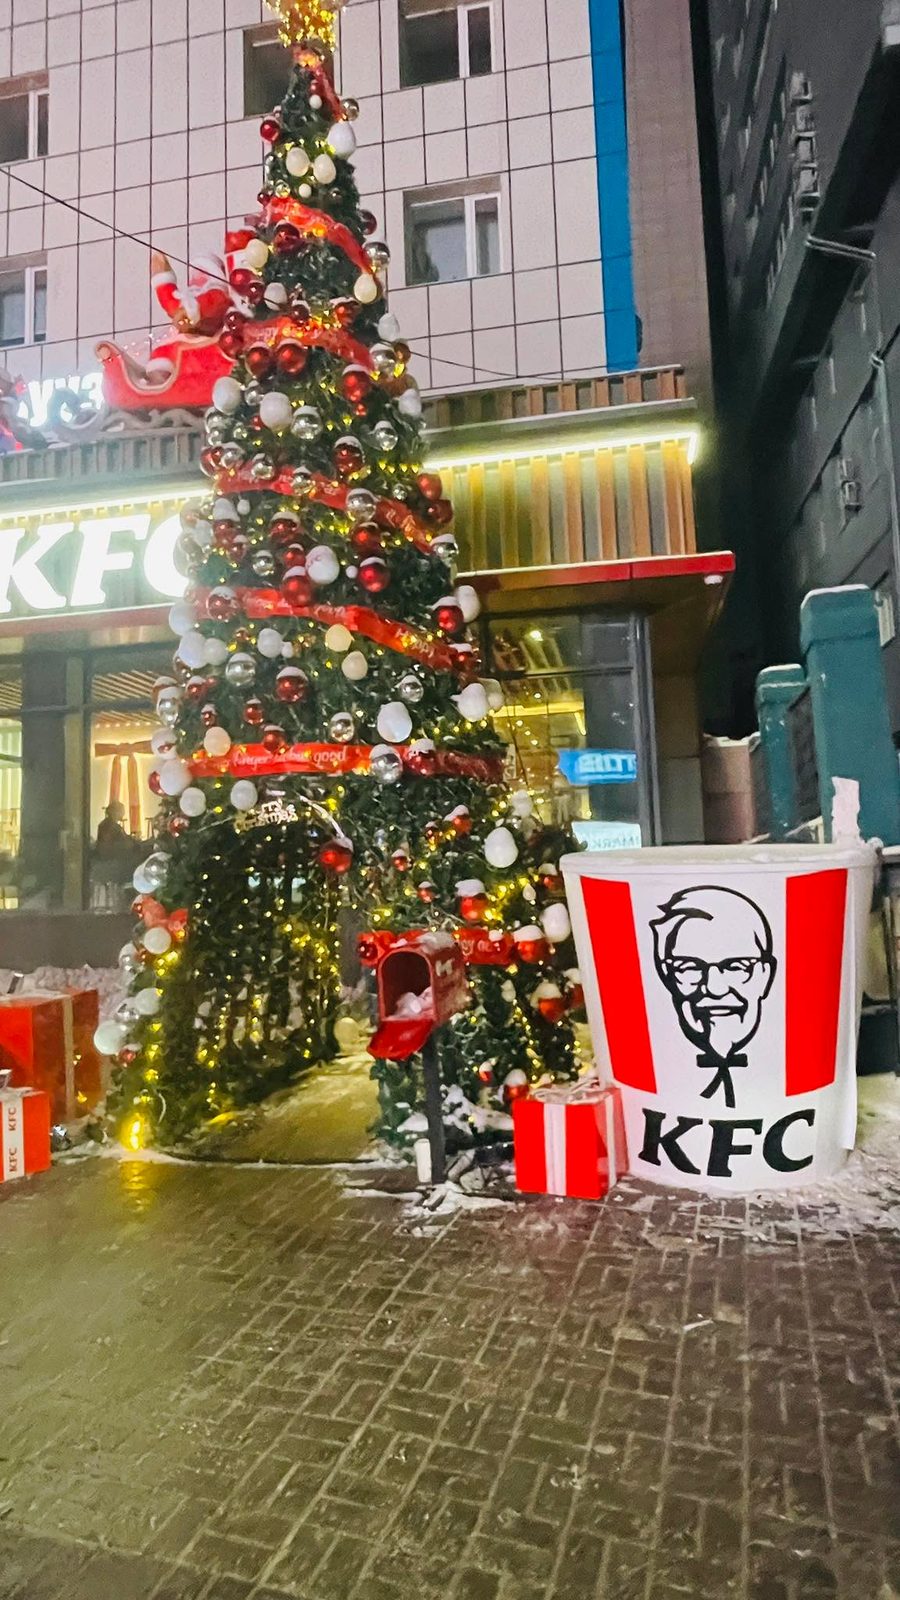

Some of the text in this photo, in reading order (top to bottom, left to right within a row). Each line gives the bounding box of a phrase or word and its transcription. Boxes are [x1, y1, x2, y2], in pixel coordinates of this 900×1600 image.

[0, 514, 189, 613] KFC
[8, 1107, 17, 1131] KFC
[638, 1107, 816, 1177] KFC
[9, 1147, 17, 1172] KFC
